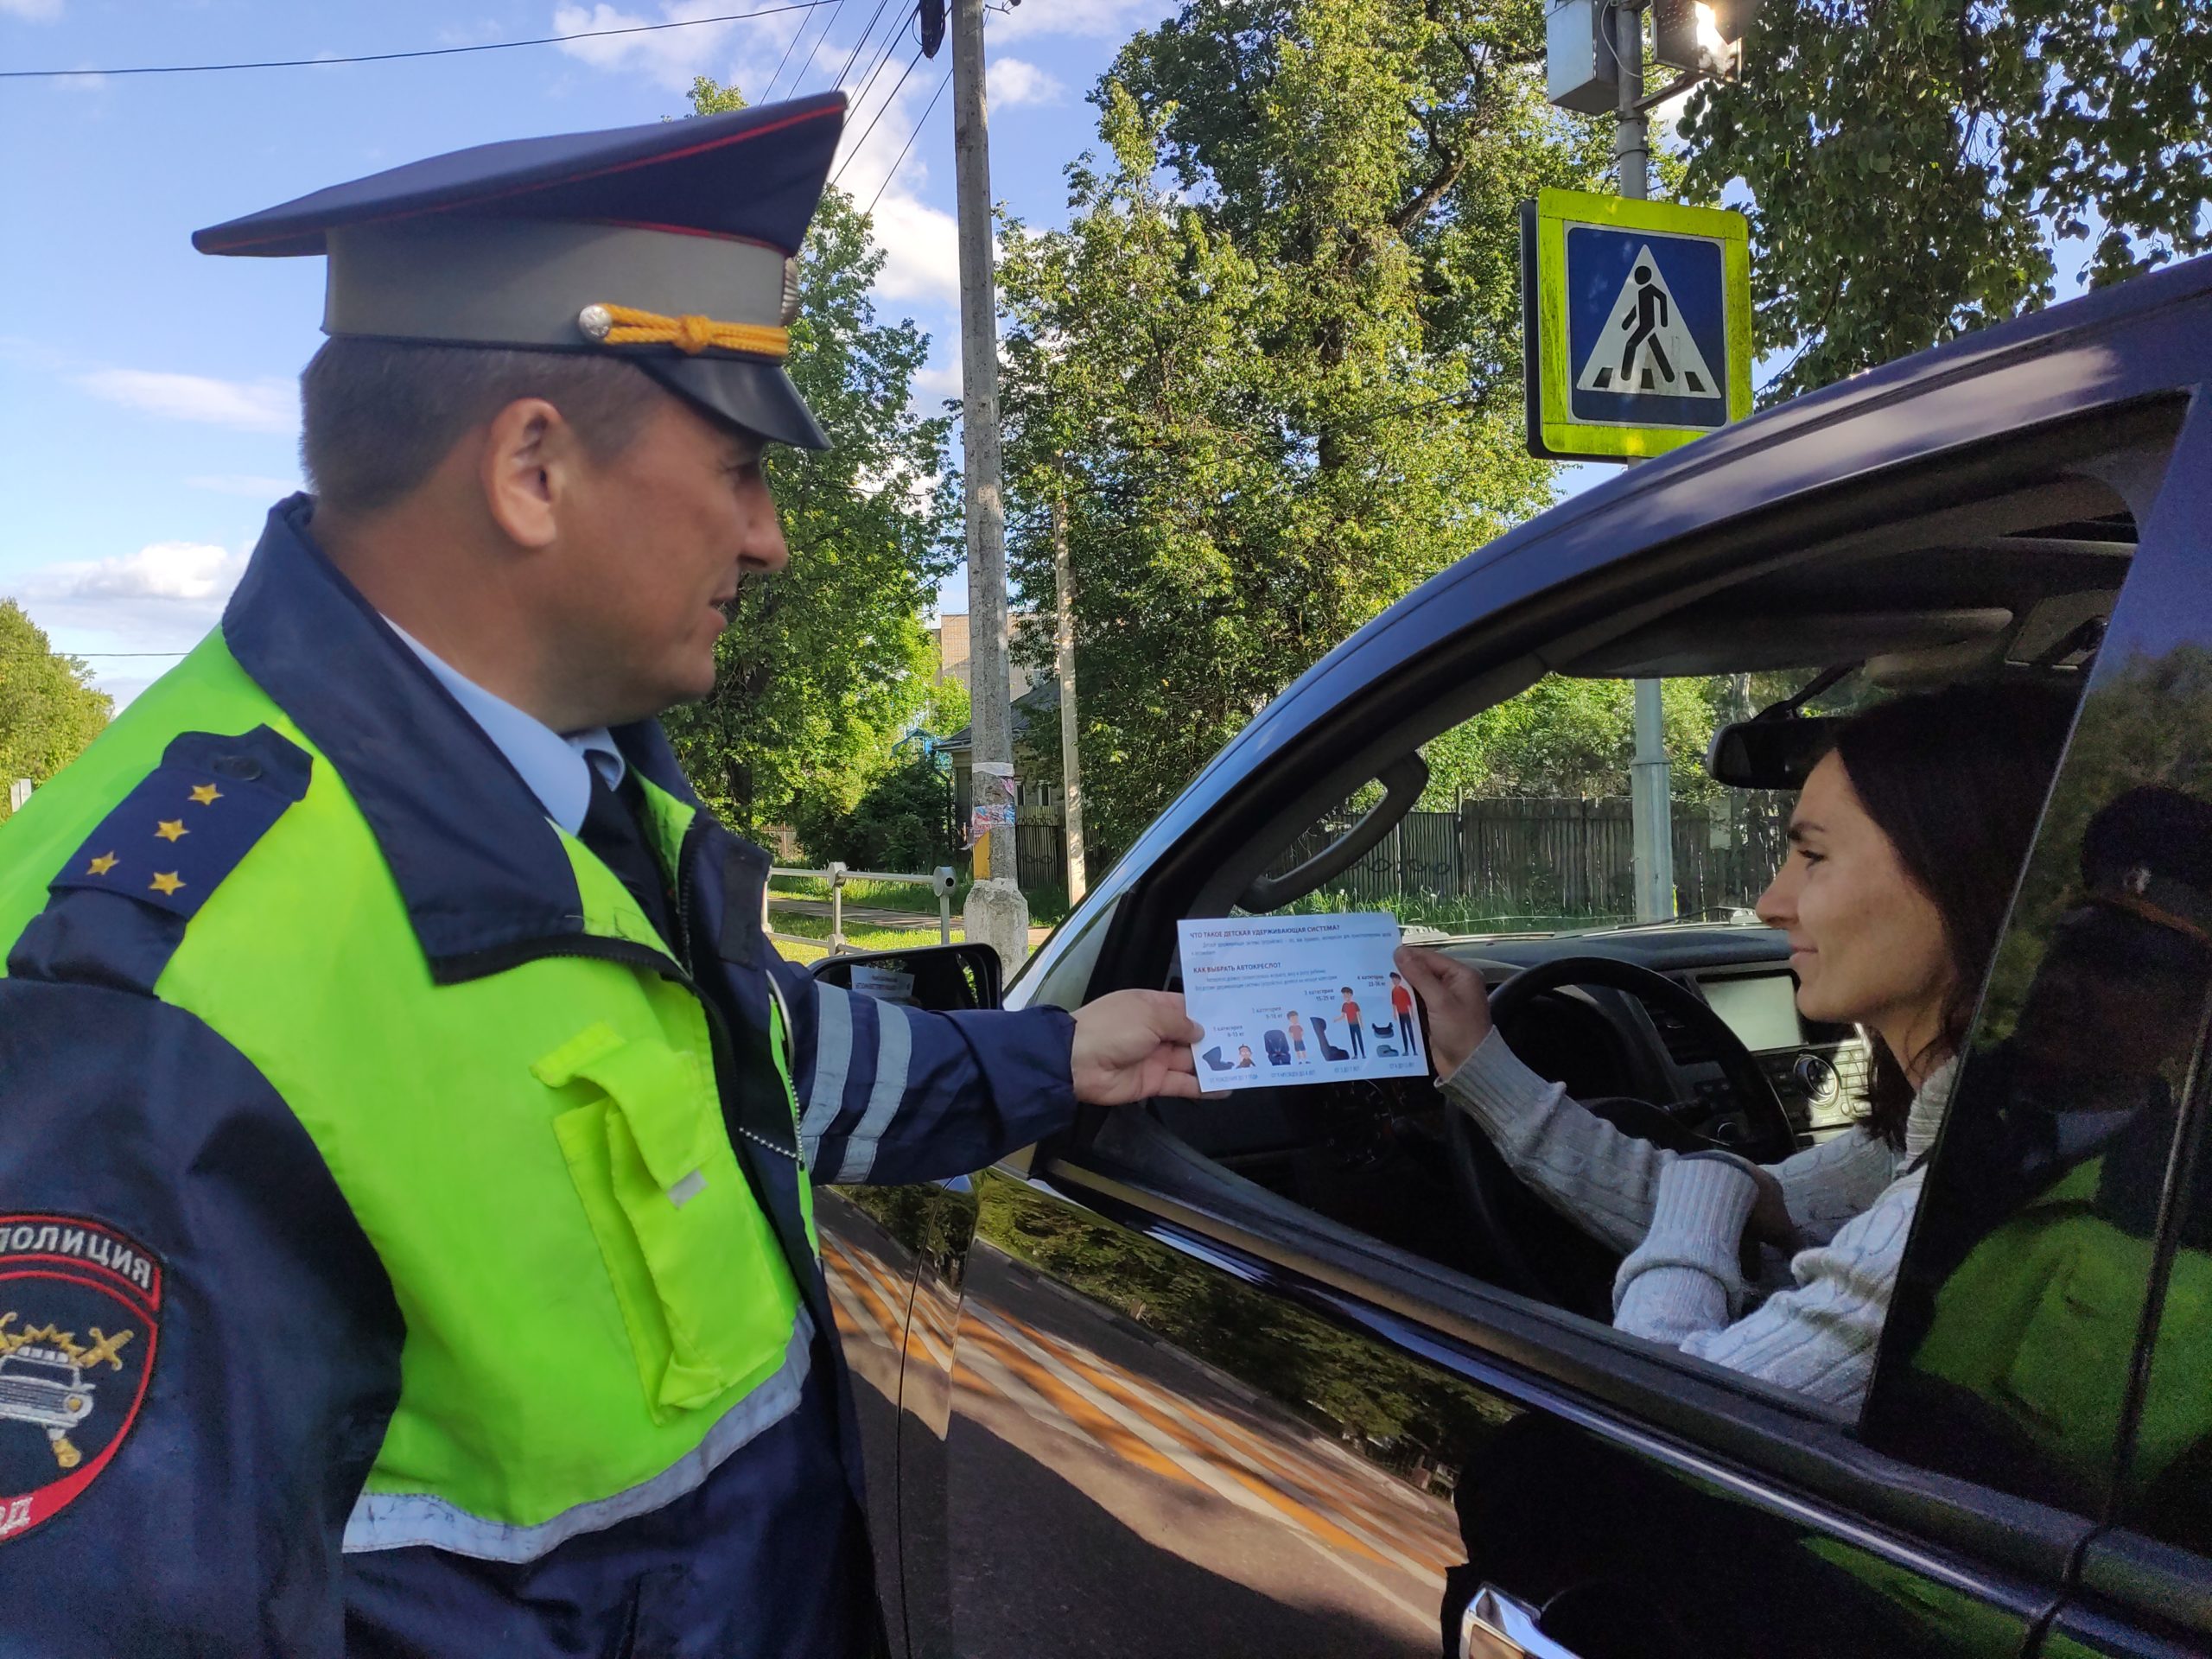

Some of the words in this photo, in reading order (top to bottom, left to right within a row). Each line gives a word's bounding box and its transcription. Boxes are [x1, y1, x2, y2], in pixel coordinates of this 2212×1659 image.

[1224, 930, 1250, 938] ДЕТСКАЯ
[1252, 926, 1306, 936] УДЕРЖИВАЮЩАЯ
[1307, 925, 1340, 933] СИСТЕМА?
[1236, 962, 1281, 971] АВТОКРЕСЛО?
